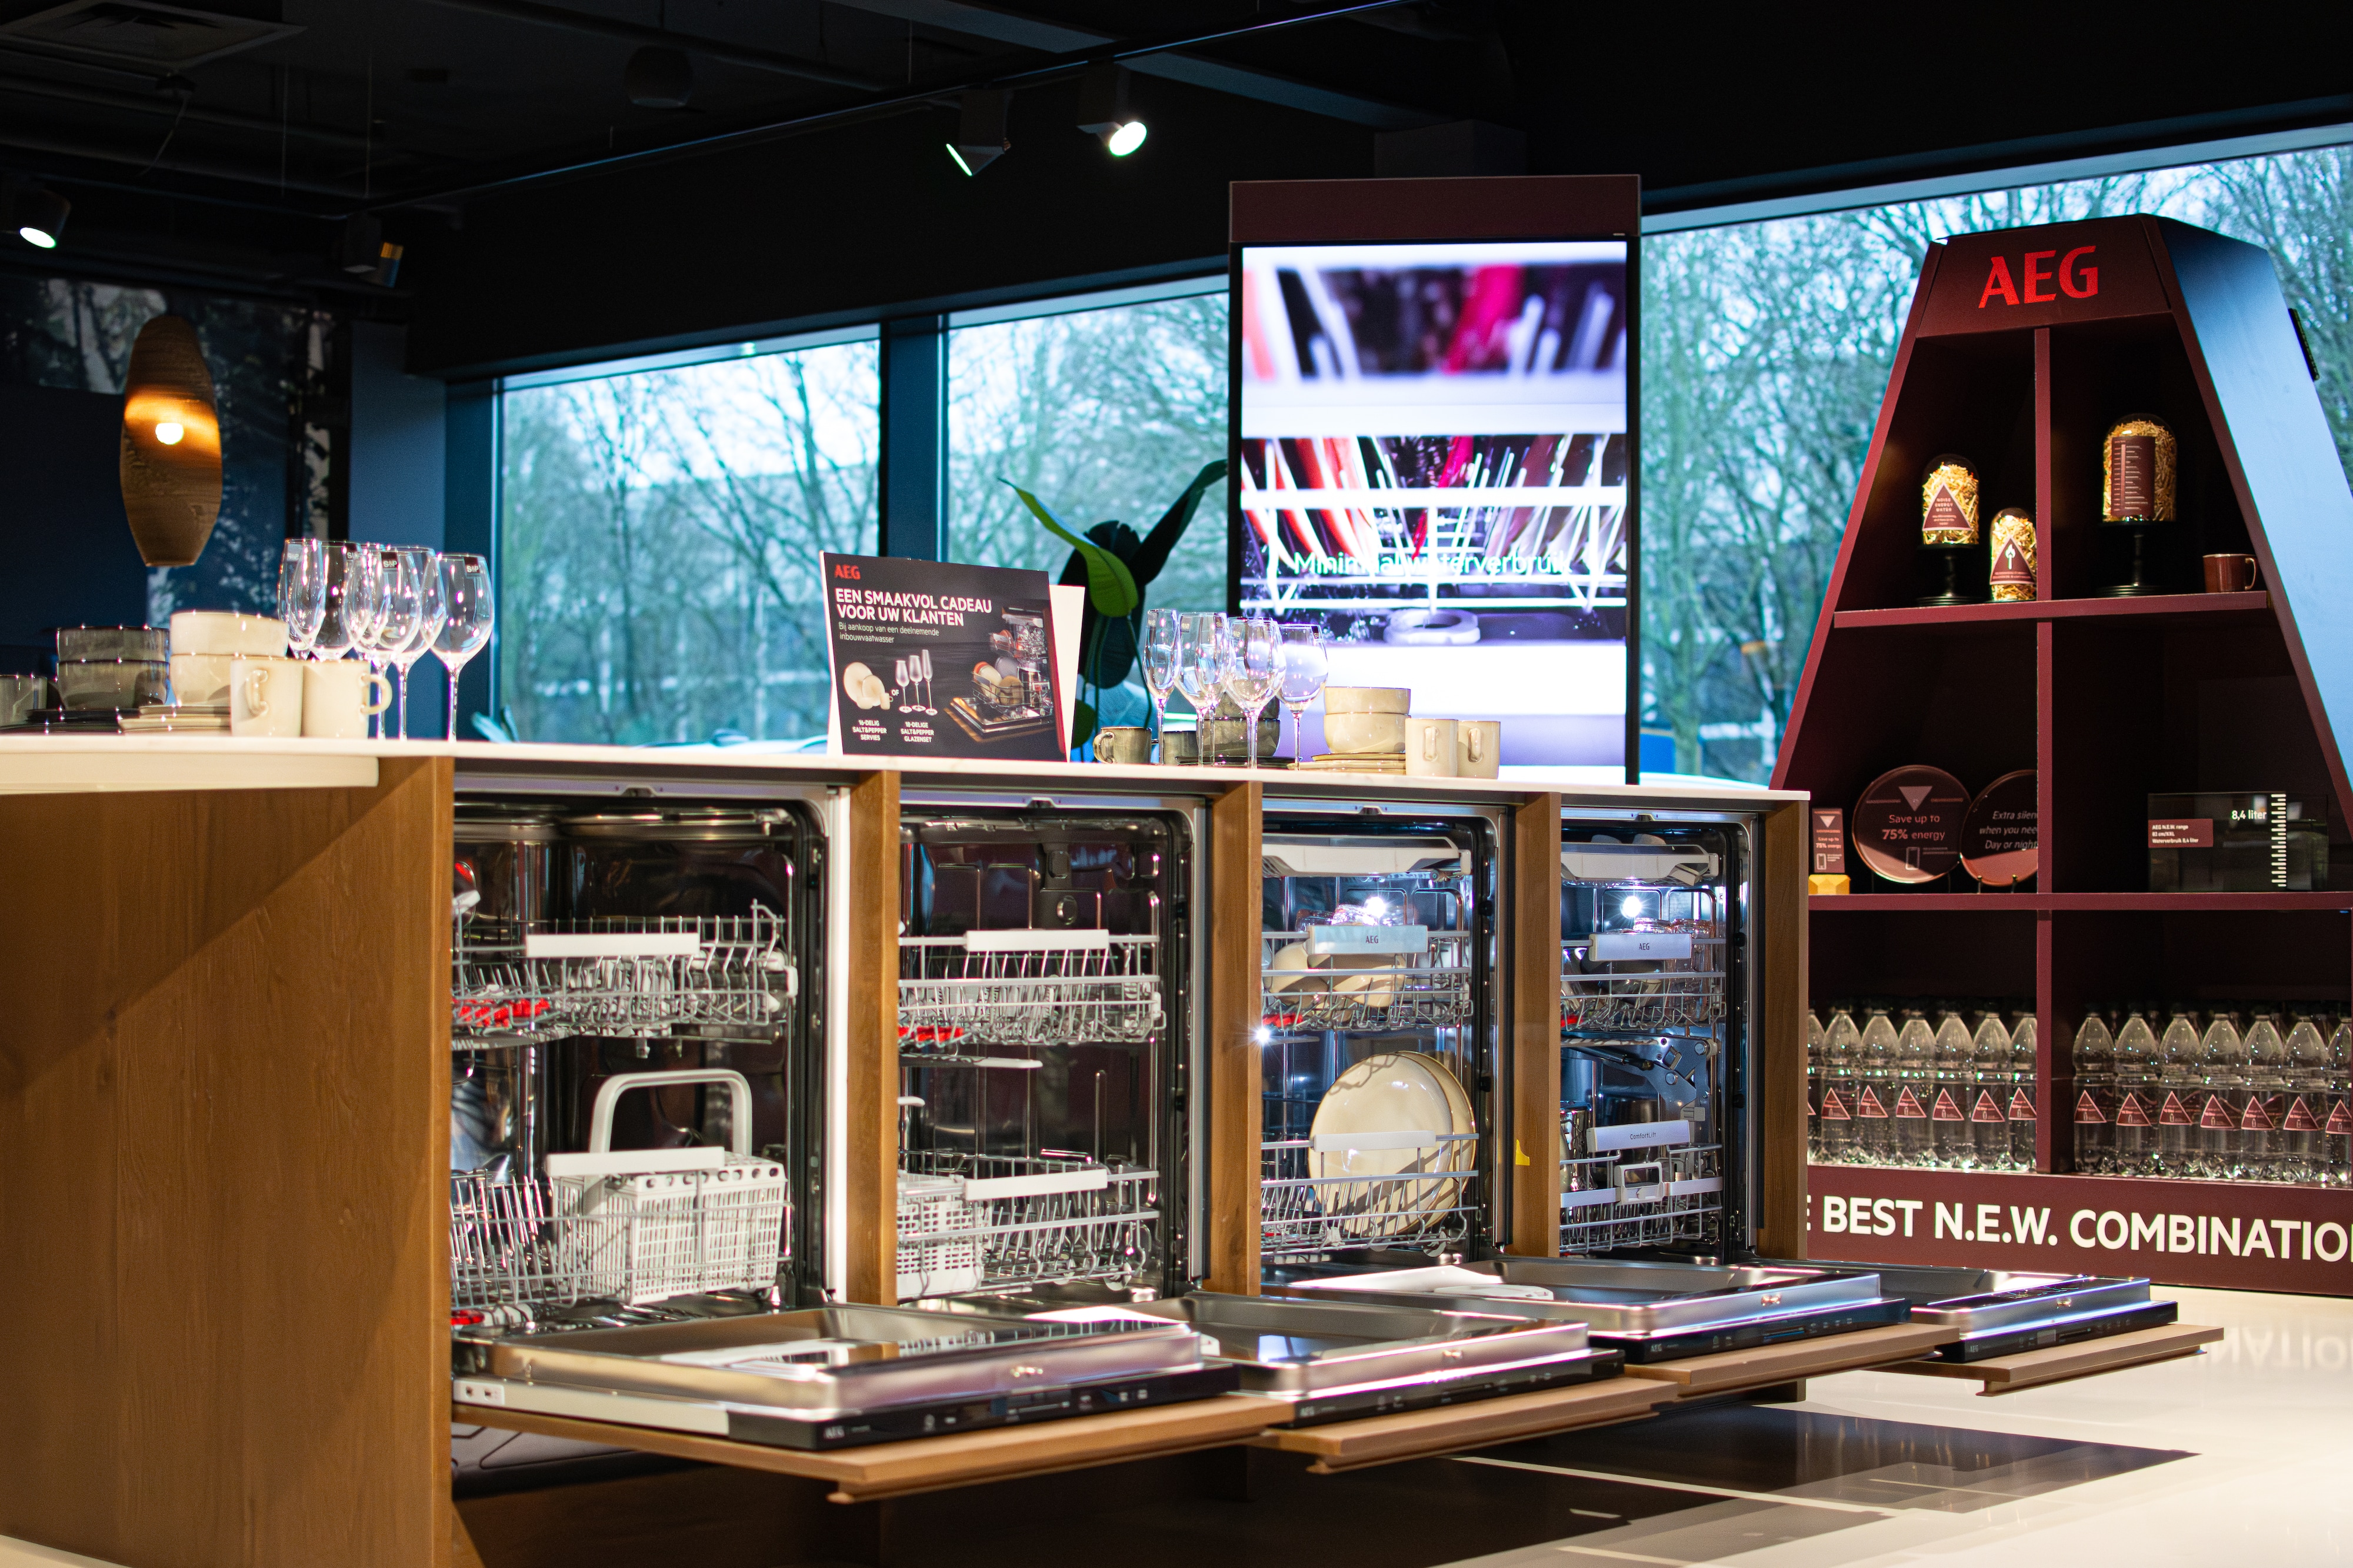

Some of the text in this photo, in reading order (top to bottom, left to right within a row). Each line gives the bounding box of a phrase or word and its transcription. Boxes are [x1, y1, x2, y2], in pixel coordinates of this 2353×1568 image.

[1978, 245, 2098, 308] AEG
[1405, 551, 1572, 575] wterverbruik
[834, 564, 861, 581] AEG
[835, 588, 992, 613] EEN SMAAKVOL CADEAU
[836, 604, 964, 626] VOOR UW KLANTEN
[839, 622, 847, 631] Bij
[848, 623, 874, 633] aankoop
[899, 626, 939, 636] deelnemende
[1889, 815, 1940, 824] Save up to
[1992, 811, 2038, 819] Extra silen
[2232, 810, 2267, 820] 8,4 liter
[1882, 829, 1945, 841] 75% energy
[1979, 826, 2001, 834] when
[2004, 827, 2019, 836] you
[1985, 840, 2002, 850] Day
[1365, 935, 1379, 944] AEG
[1638, 942, 1650, 950] AEG
[1629, 1132, 1657, 1140] ComfortLift
[1824, 1195, 1923, 1237] BEST
[1935, 1202, 2058, 1246] N.E.W.
[2069, 1209, 2353, 1263] COMBINATIO
